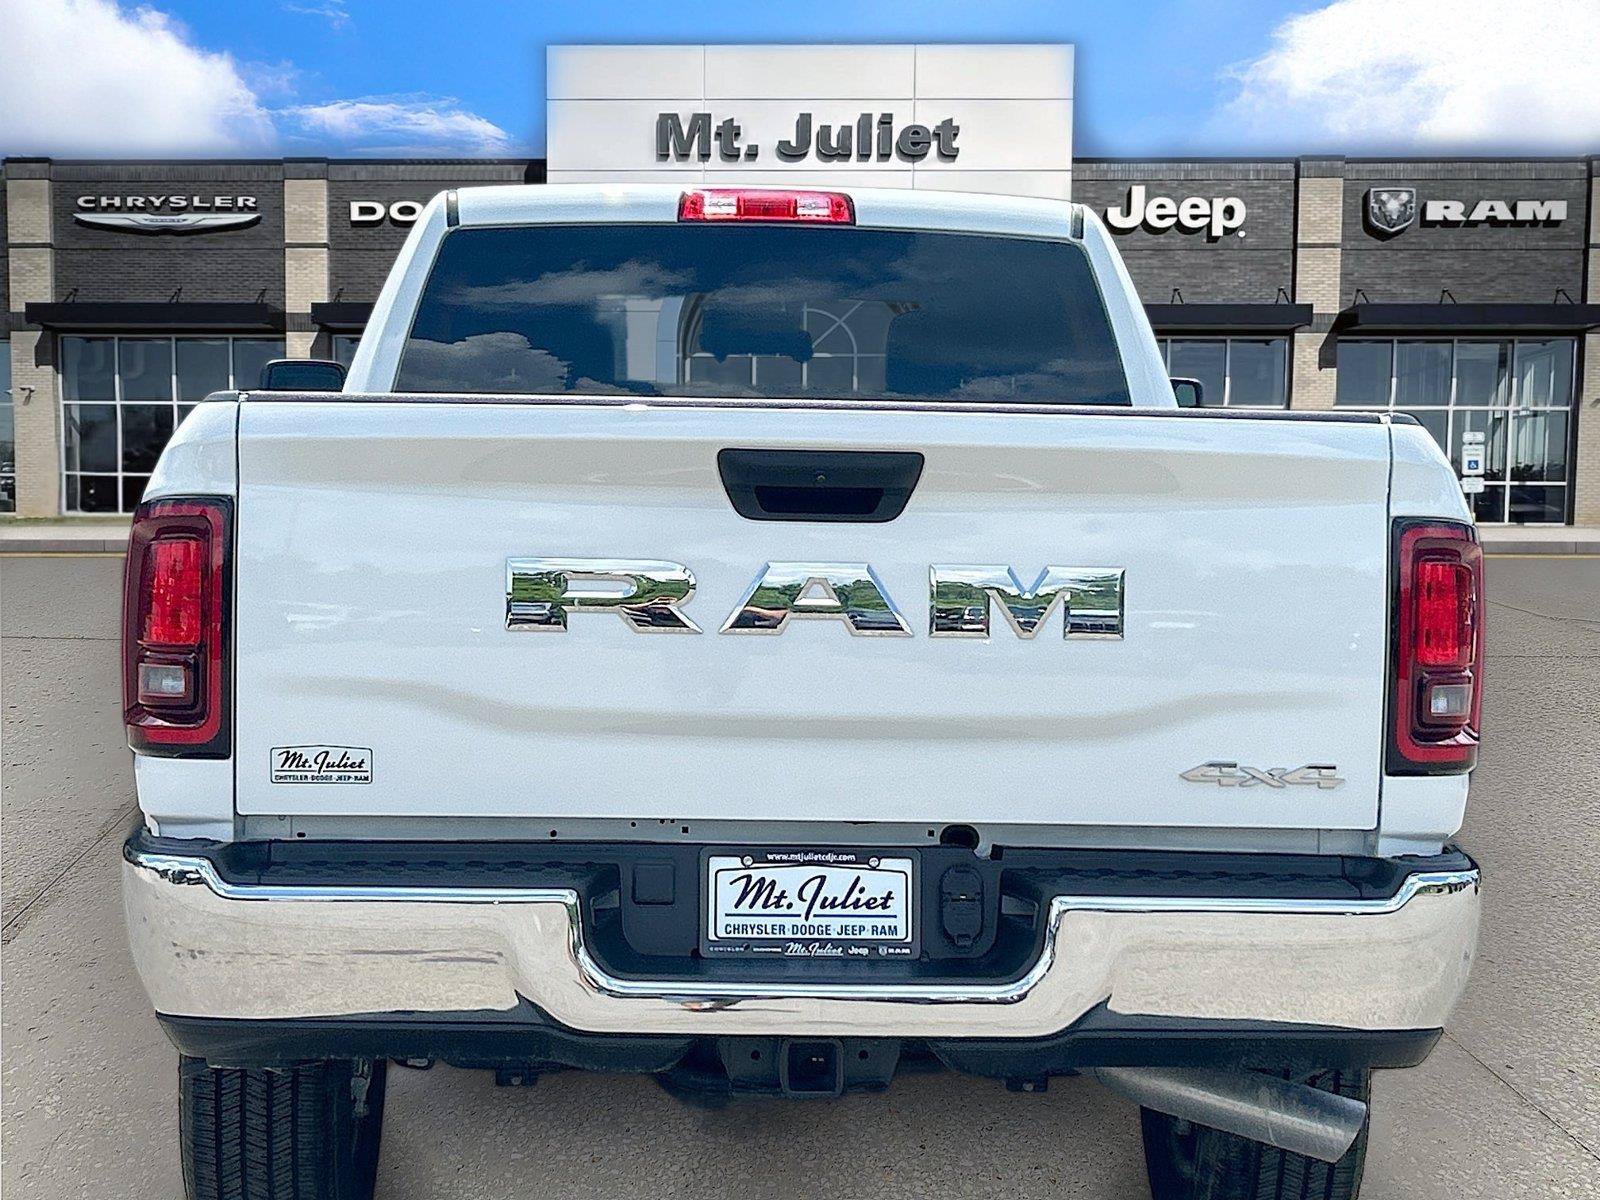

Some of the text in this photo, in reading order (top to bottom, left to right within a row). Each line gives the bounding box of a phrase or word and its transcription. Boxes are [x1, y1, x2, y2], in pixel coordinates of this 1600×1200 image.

[656, 112, 960, 162] Mt. Juliet
[77, 196, 257, 207] CHRYSLER
[1107, 185, 1246, 237] Jeep
[1426, 200, 1568, 220] RAM
[505, 557, 1125, 641] RAM
[278, 750, 365, 774] Mt. Juliet
[729, 874, 894, 922] Mt. Juliet
[725, 923, 897, 936] CHRYSLER DODGE JEEP RAM
